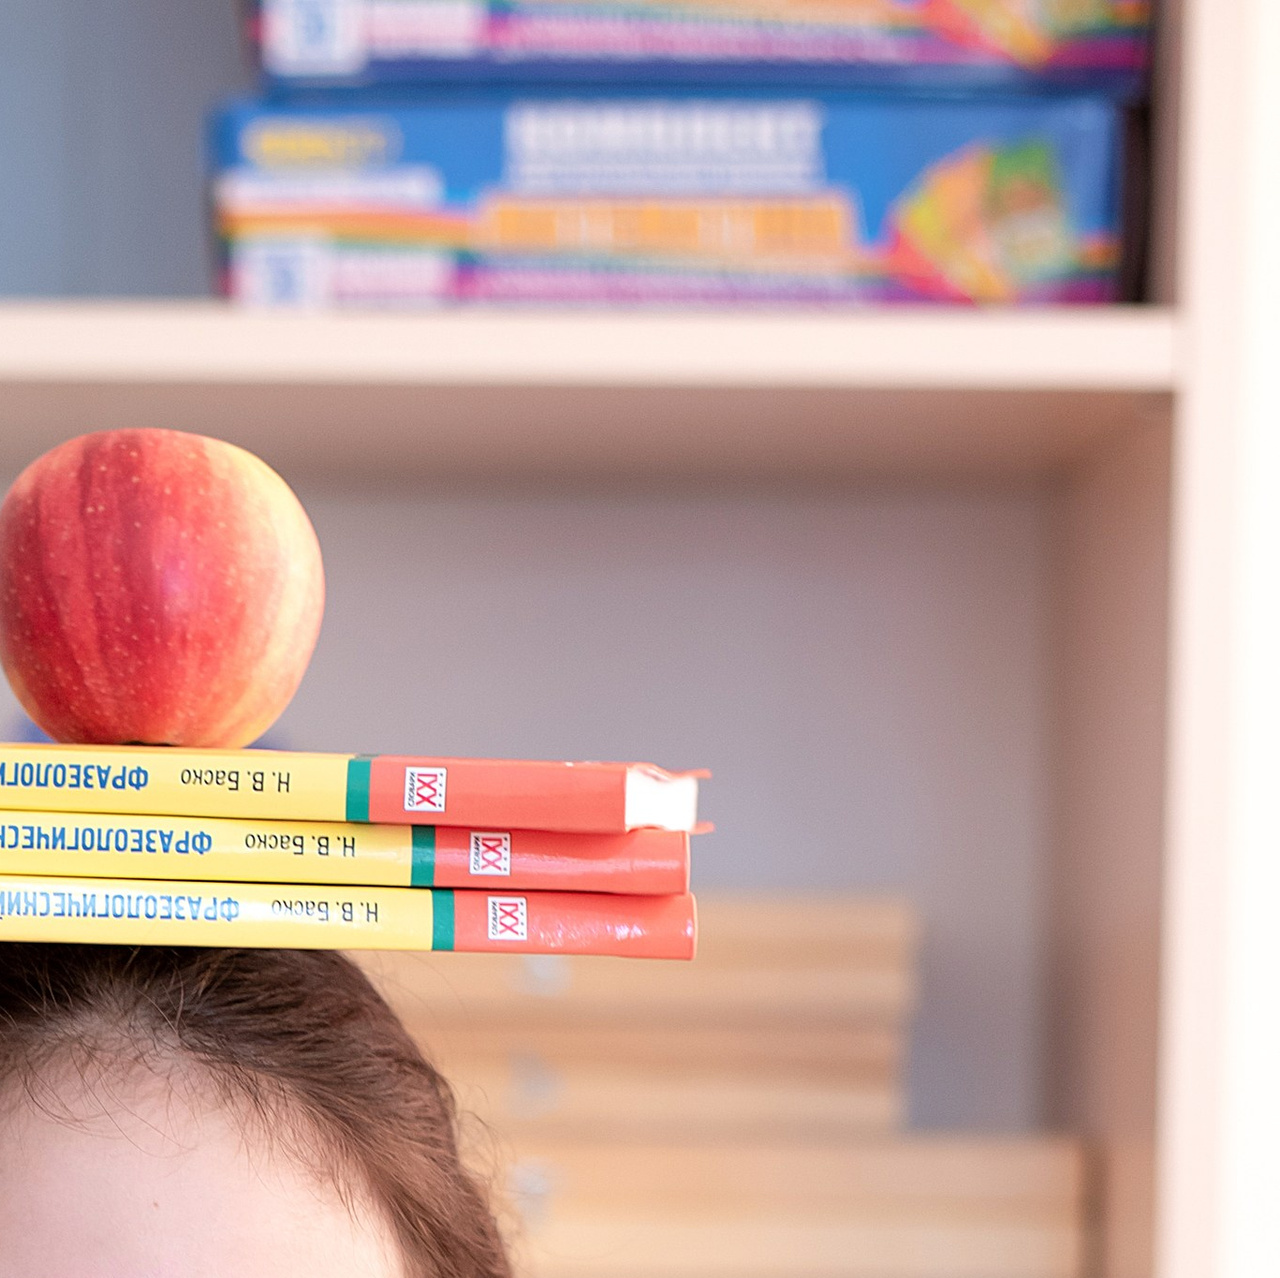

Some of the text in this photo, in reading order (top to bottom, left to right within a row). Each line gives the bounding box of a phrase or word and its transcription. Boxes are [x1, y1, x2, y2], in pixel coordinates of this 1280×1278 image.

[180, 768, 240, 791] Баско
[247, 770, 265, 792] В.
[272, 771, 291, 794] Н.
[244, 833, 304, 856] Баско
[311, 835, 330, 856] В.
[336, 836, 356, 857] Н.
[271, 899, 329, 922] Баско
[335, 901, 354, 922] В.
[359, 901, 378, 923] Н.
